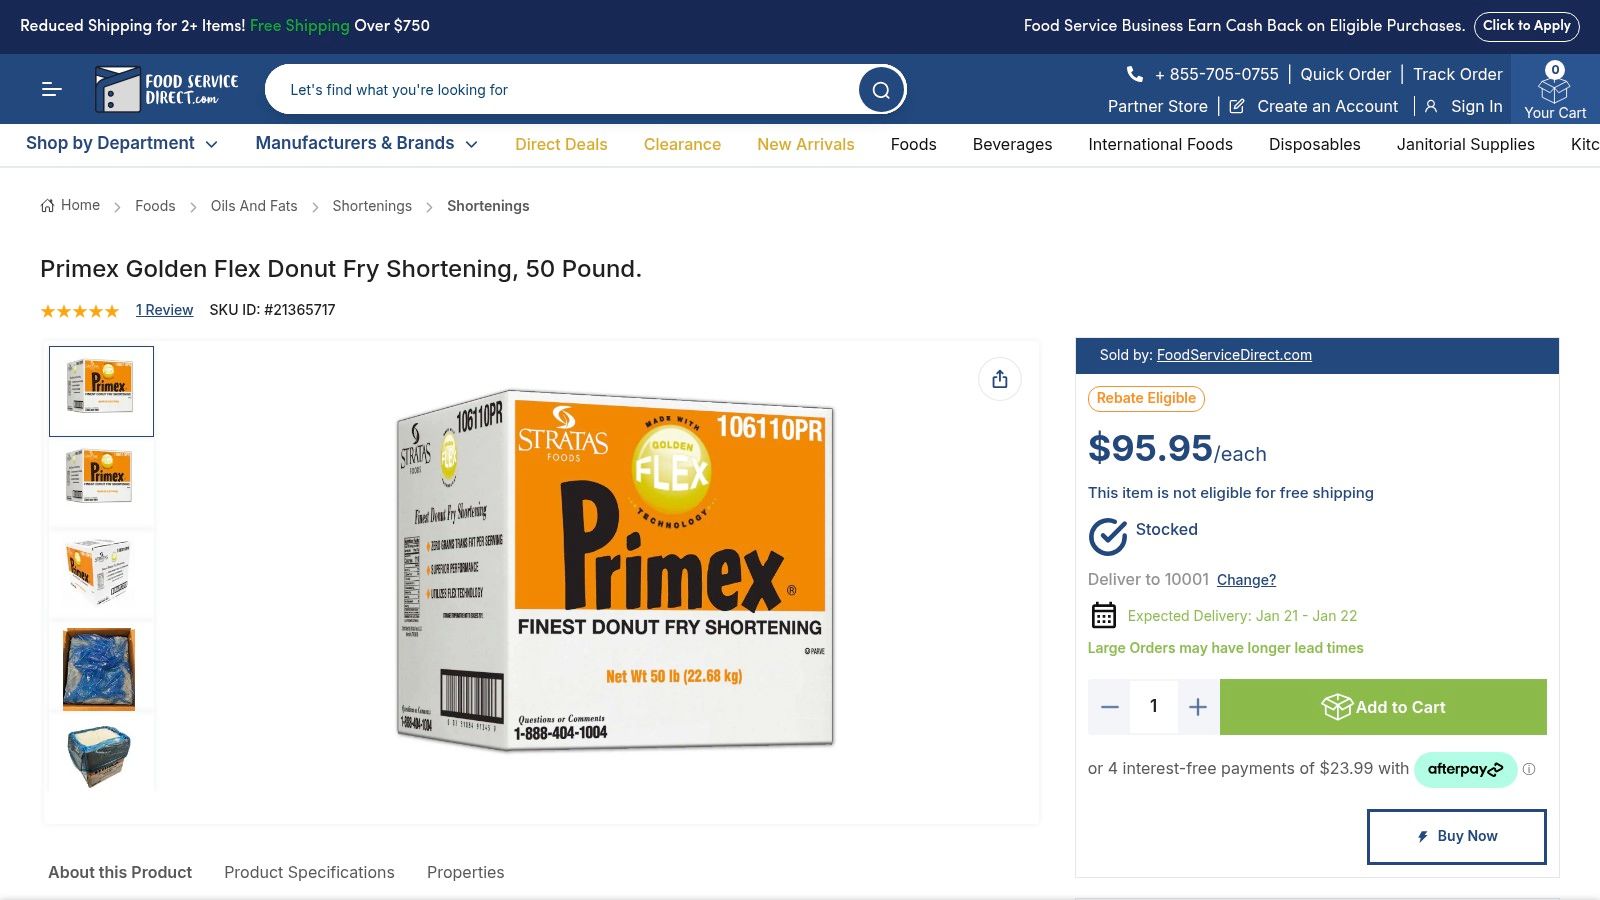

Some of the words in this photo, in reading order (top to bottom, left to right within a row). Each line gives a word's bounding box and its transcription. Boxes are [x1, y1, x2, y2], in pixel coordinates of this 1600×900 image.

[20, 18, 84, 32] Reduced
[88, 18, 152, 36] Shipping
[155, 18, 178, 32] for
[181, 19, 198, 32] 2+
[202, 18, 246, 32] Items!
[250, 18, 282, 32] Free
[286, 18, 350, 36] Shipping
[354, 18, 391, 32] Over
[393, 17, 430, 34] $750
[1024, 18, 1060, 32] Food
[1064, 18, 1118, 32] Service
[1122, 18, 1184, 32] Business
[1188, 18, 1222, 32] Earn
[1225, 18, 1263, 32] Cash
[1267, 18, 1303, 32] Back
[1307, 22, 1325, 32] on
[1330, 18, 1383, 36] Eligible
[1387, 18, 1466, 32] Purchases.
[1482, 18, 1515, 31] Click
[1517, 19, 1531, 31] to
[1533, 18, 1572, 34] Apply
[1300, 67, 1345, 82] Quick
[1348, 67, 1392, 81] Order
[1412, 67, 1456, 81] Track
[1459, 67, 1504, 81] Order
[1551, 64, 1560, 75] 0
[145, 73, 183, 89] FOOD
[187, 73, 239, 89] SERVICE
[290, 83, 323, 96] Let's
[326, 83, 352, 96] find
[356, 83, 389, 96] what
[391, 83, 434, 99] you're
[438, 83, 486, 99] looking
[489, 83, 509, 96] for
[1108, 99, 1164, 113] Partner
[1168, 99, 1209, 113] Store
[1257, 99, 1308, 113] Create
[1312, 102, 1331, 113] an
[1335, 99, 1399, 113] Account
[1451, 99, 1485, 116] Sign
[1489, 99, 1503, 113] In
[1524, 106, 1556, 119] Your
[1558, 106, 1588, 119] Cart
[26, 135, 69, 154] Shop
[72, 135, 94, 154] by
[97, 135, 195, 154] Department
[256, 134, 377, 150] Manufacturers
[381, 135, 393, 150] &
[397, 135, 455, 150] Brands
[515, 137, 561, 151] Direct
[564, 137, 608, 151] Deals
[643, 137, 722, 151] Clearance
[757, 137, 792, 151] New
[796, 137, 855, 151] Arrivals
[891, 137, 937, 151] Foods
[973, 137, 1053, 154] Beverages
[1089, 137, 1182, 151] International
[1187, 137, 1233, 151] Foods
[1269, 137, 1361, 154] Disposables
[1396, 137, 1466, 151] Janitorial
[1470, 137, 1536, 154] Supplies
[61, 198, 101, 211] Home
[135, 199, 176, 212] Foods
[332, 199, 413, 215] Shortenings
[447, 199, 530, 215] Shortenings
[41, 259, 119, 278] Primex
[126, 259, 207, 278] Golden
[215, 259, 261, 278] Flex
[268, 259, 337, 278] Donut
[343, 259, 380, 283] Fry
[386, 258, 518, 283] Shortening,
[526, 259, 555, 278] 50
[562, 259, 642, 278] Pound.
[136, 303, 142, 316] 1
[145, 303, 194, 316] Review
[209, 303, 239, 316] SKU
[242, 303, 260, 316] ID:
[263, 303, 336, 316] #21365717
[1099, 348, 1129, 361] Sold
[1133, 348, 1153, 364] by:
[1157, 348, 1312, 361] FoodServiceDirect.com
[91, 371, 126, 393] Primex
[1096, 391, 1144, 404] Rebate
[1147, 391, 1197, 407] Eligible
[456, 400, 503, 433] 106110PR
[644, 415, 673, 429] MADE
[676, 415, 702, 432] WITH
[716, 413, 823, 442] 106110PR
[517, 427, 610, 457] STRATAS
[651, 440, 695, 453] GOLDEN
[400, 442, 432, 470] STRATAS
[546, 452, 581, 463] FOODS
[90, 461, 125, 482] Primex
[634, 454, 711, 492] FLEX
[1087, 486, 1119, 499] This
[1122, 486, 1153, 499] item
[1157, 486, 1169, 499] is
[1173, 487, 1197, 499] not
[1200, 486, 1252, 502] eligible
[1255, 486, 1277, 499] for
[1279, 486, 1309, 499] free
[1312, 486, 1374, 502] shipping
[414, 509, 430, 525] Finest
[447, 504, 457, 525] Fry
[457, 501, 488, 521] Shortening
[636, 507, 709, 530] TECHNOLOGY
[1136, 522, 1198, 536] Stocked
[560, 479, 785, 613] Primex
[1088, 572, 1142, 586] Deliver
[1145, 573, 1161, 586] to
[1164, 572, 1209, 586] 10001
[1217, 573, 1277, 589] Change?
[518, 618, 587, 635] FINEST
[592, 618, 660, 635] DONUT
[665, 619, 701, 635] FRY
[705, 619, 822, 636] SHORTENING
[1087, 641, 1127, 657] Large
[1129, 641, 1176, 654] Orders
[1179, 644, 1209, 657] may
[1211, 641, 1245, 654] have
[1247, 641, 1291, 657] longer
[1294, 641, 1324, 654] lead
[1326, 640, 1364, 654] times
[606, 669, 628, 684] Net
[630, 669, 648, 683] Wt
[650, 669, 666, 683] 50
[669, 669, 681, 683] lb
[683, 668, 721, 686] (22.68
[723, 669, 743, 685] kg)
[1150, 698, 1157, 713] 1
[1355, 700, 1388, 714] Add
[1391, 701, 1408, 714] to
[1411, 700, 1446, 714] Cart
[518, 714, 556, 726] Questions
[557, 716, 566, 724] or
[567, 714, 607, 724] Comments
[513, 725, 609, 741] 1-888-404-1004
[1427, 762, 1487, 778] afterpay
[1438, 829, 1465, 845] Buy
[1467, 829, 1499, 842] Now
[47, 865, 96, 879] About
[98, 864, 128, 879] this
[131, 865, 193, 879] Product
[427, 865, 505, 882] Properties
